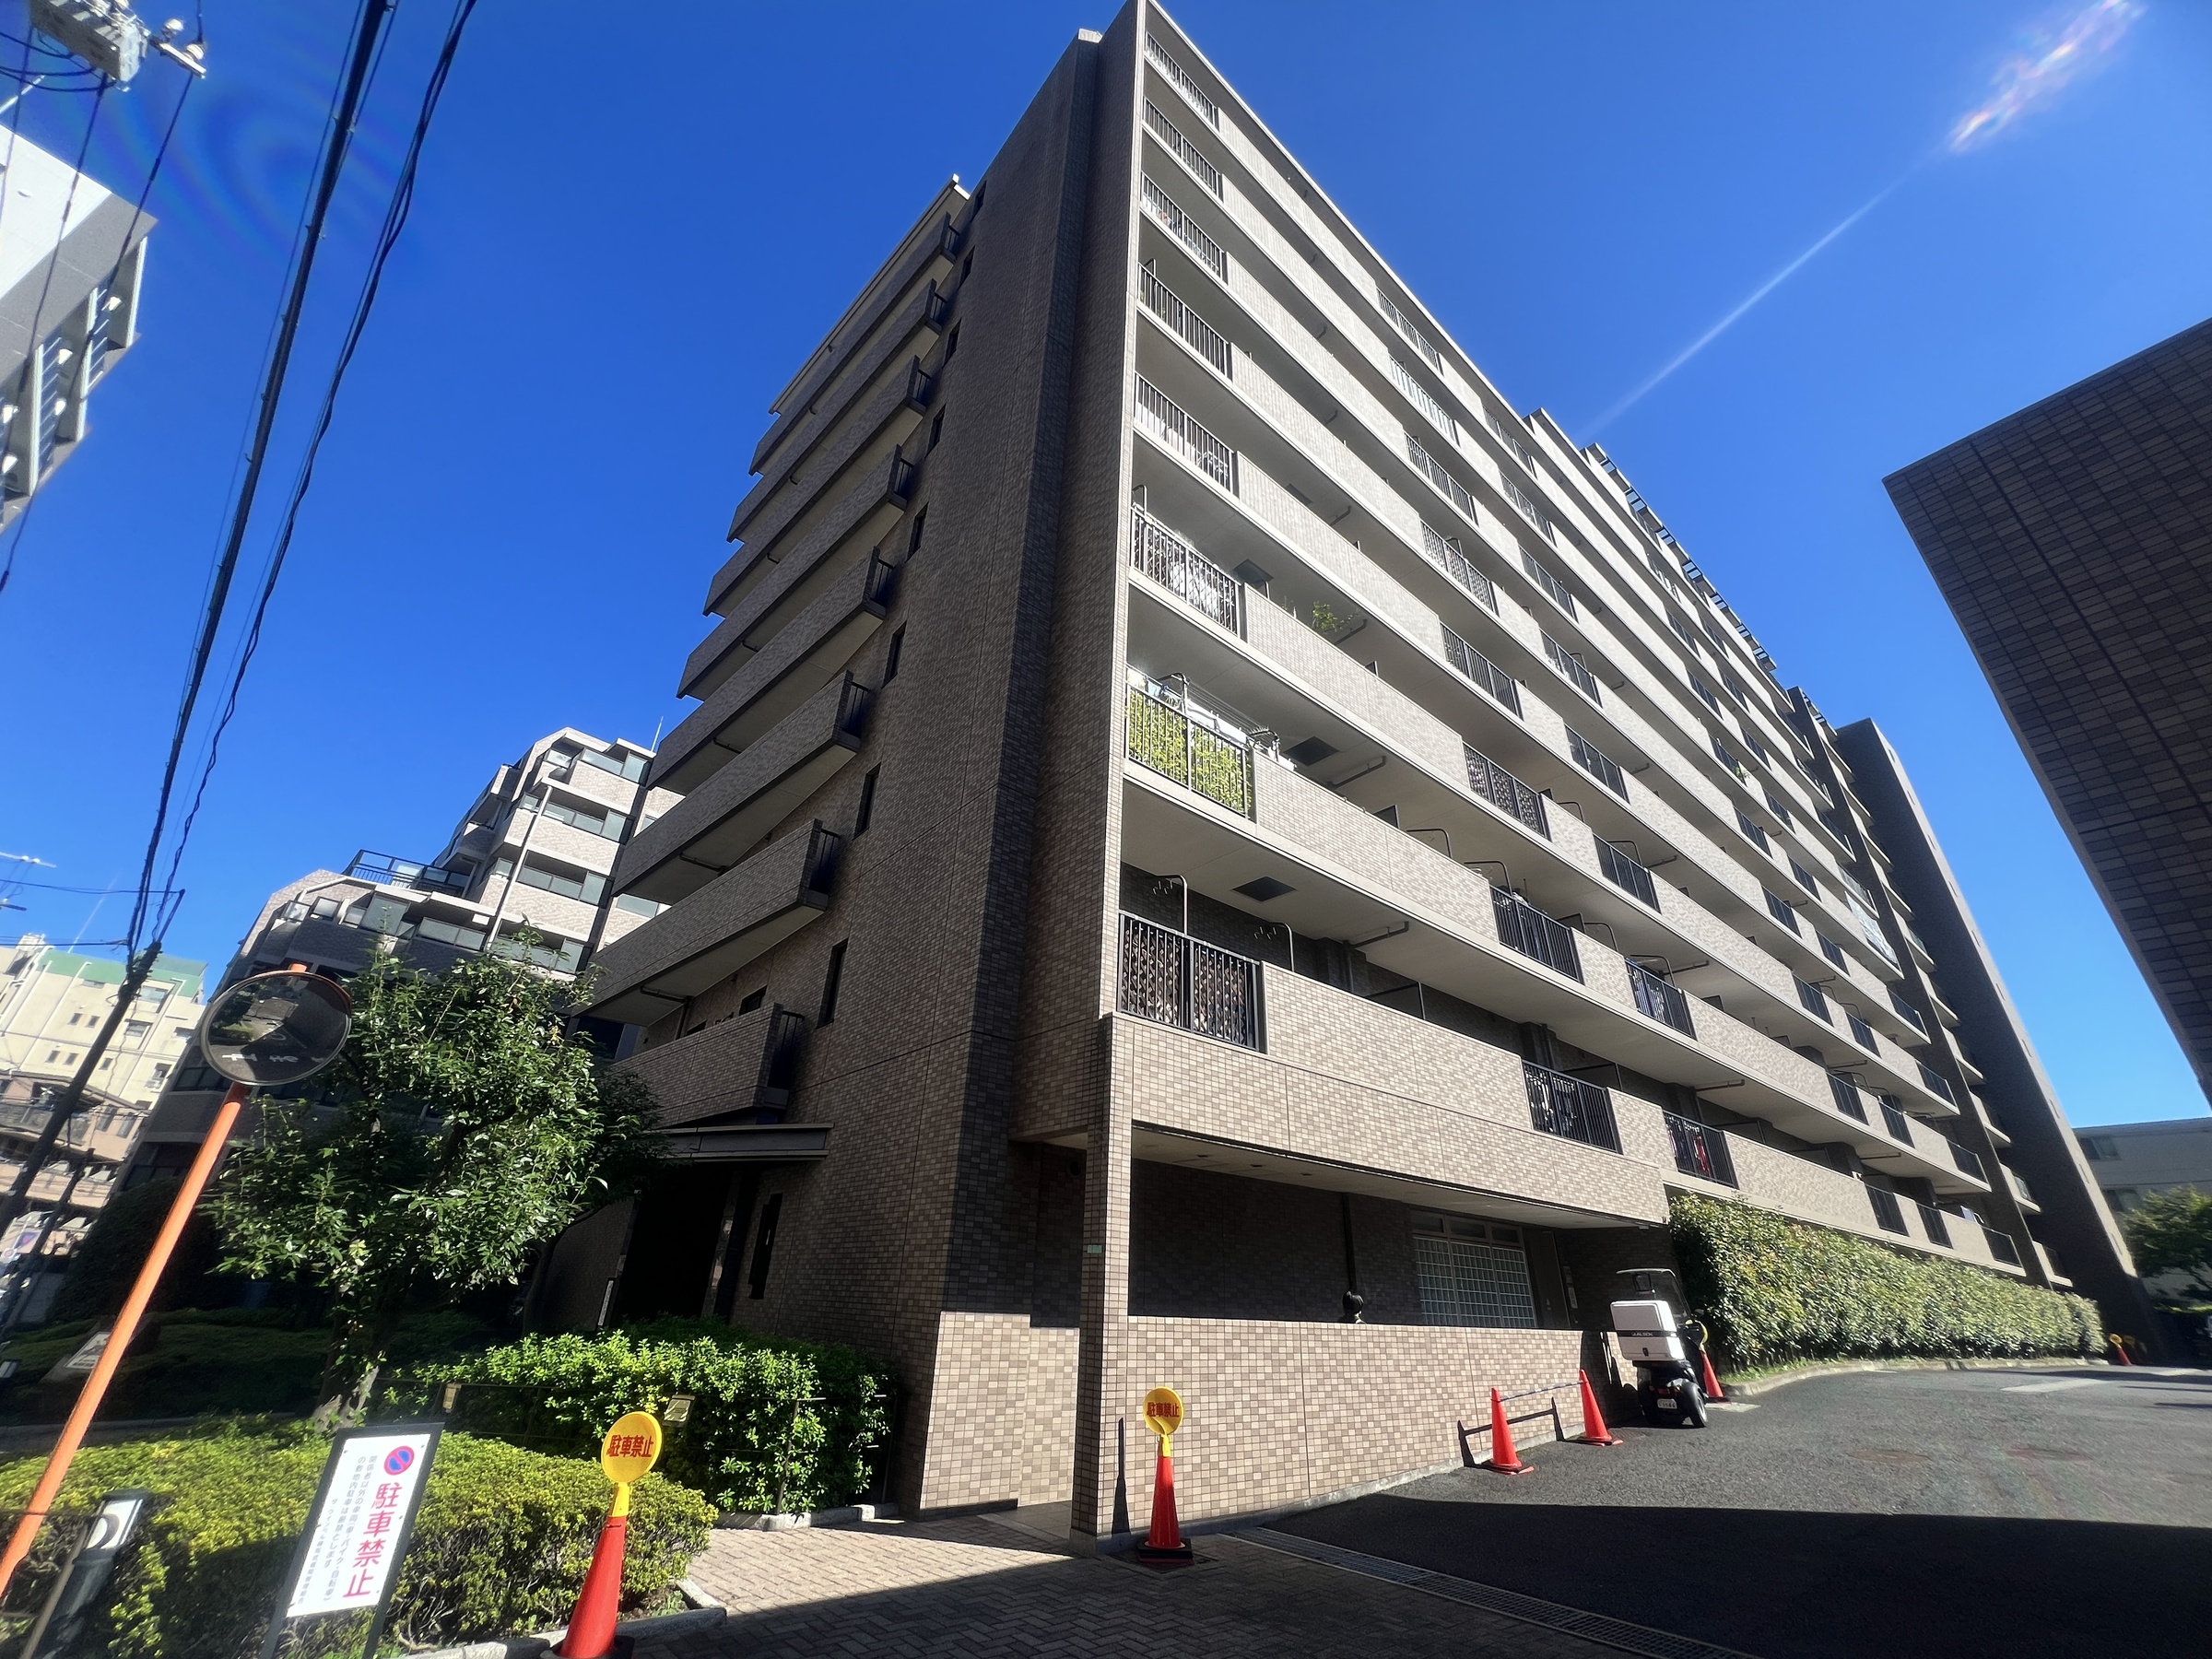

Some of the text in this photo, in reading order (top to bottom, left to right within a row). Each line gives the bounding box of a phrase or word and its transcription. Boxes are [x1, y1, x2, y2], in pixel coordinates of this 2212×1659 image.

[1147, 1402, 1180, 1418] 駐車禁止
[606, 1434, 653, 1457] 駐車禁止
[343, 1482, 402, 1597] 駐車禁止
